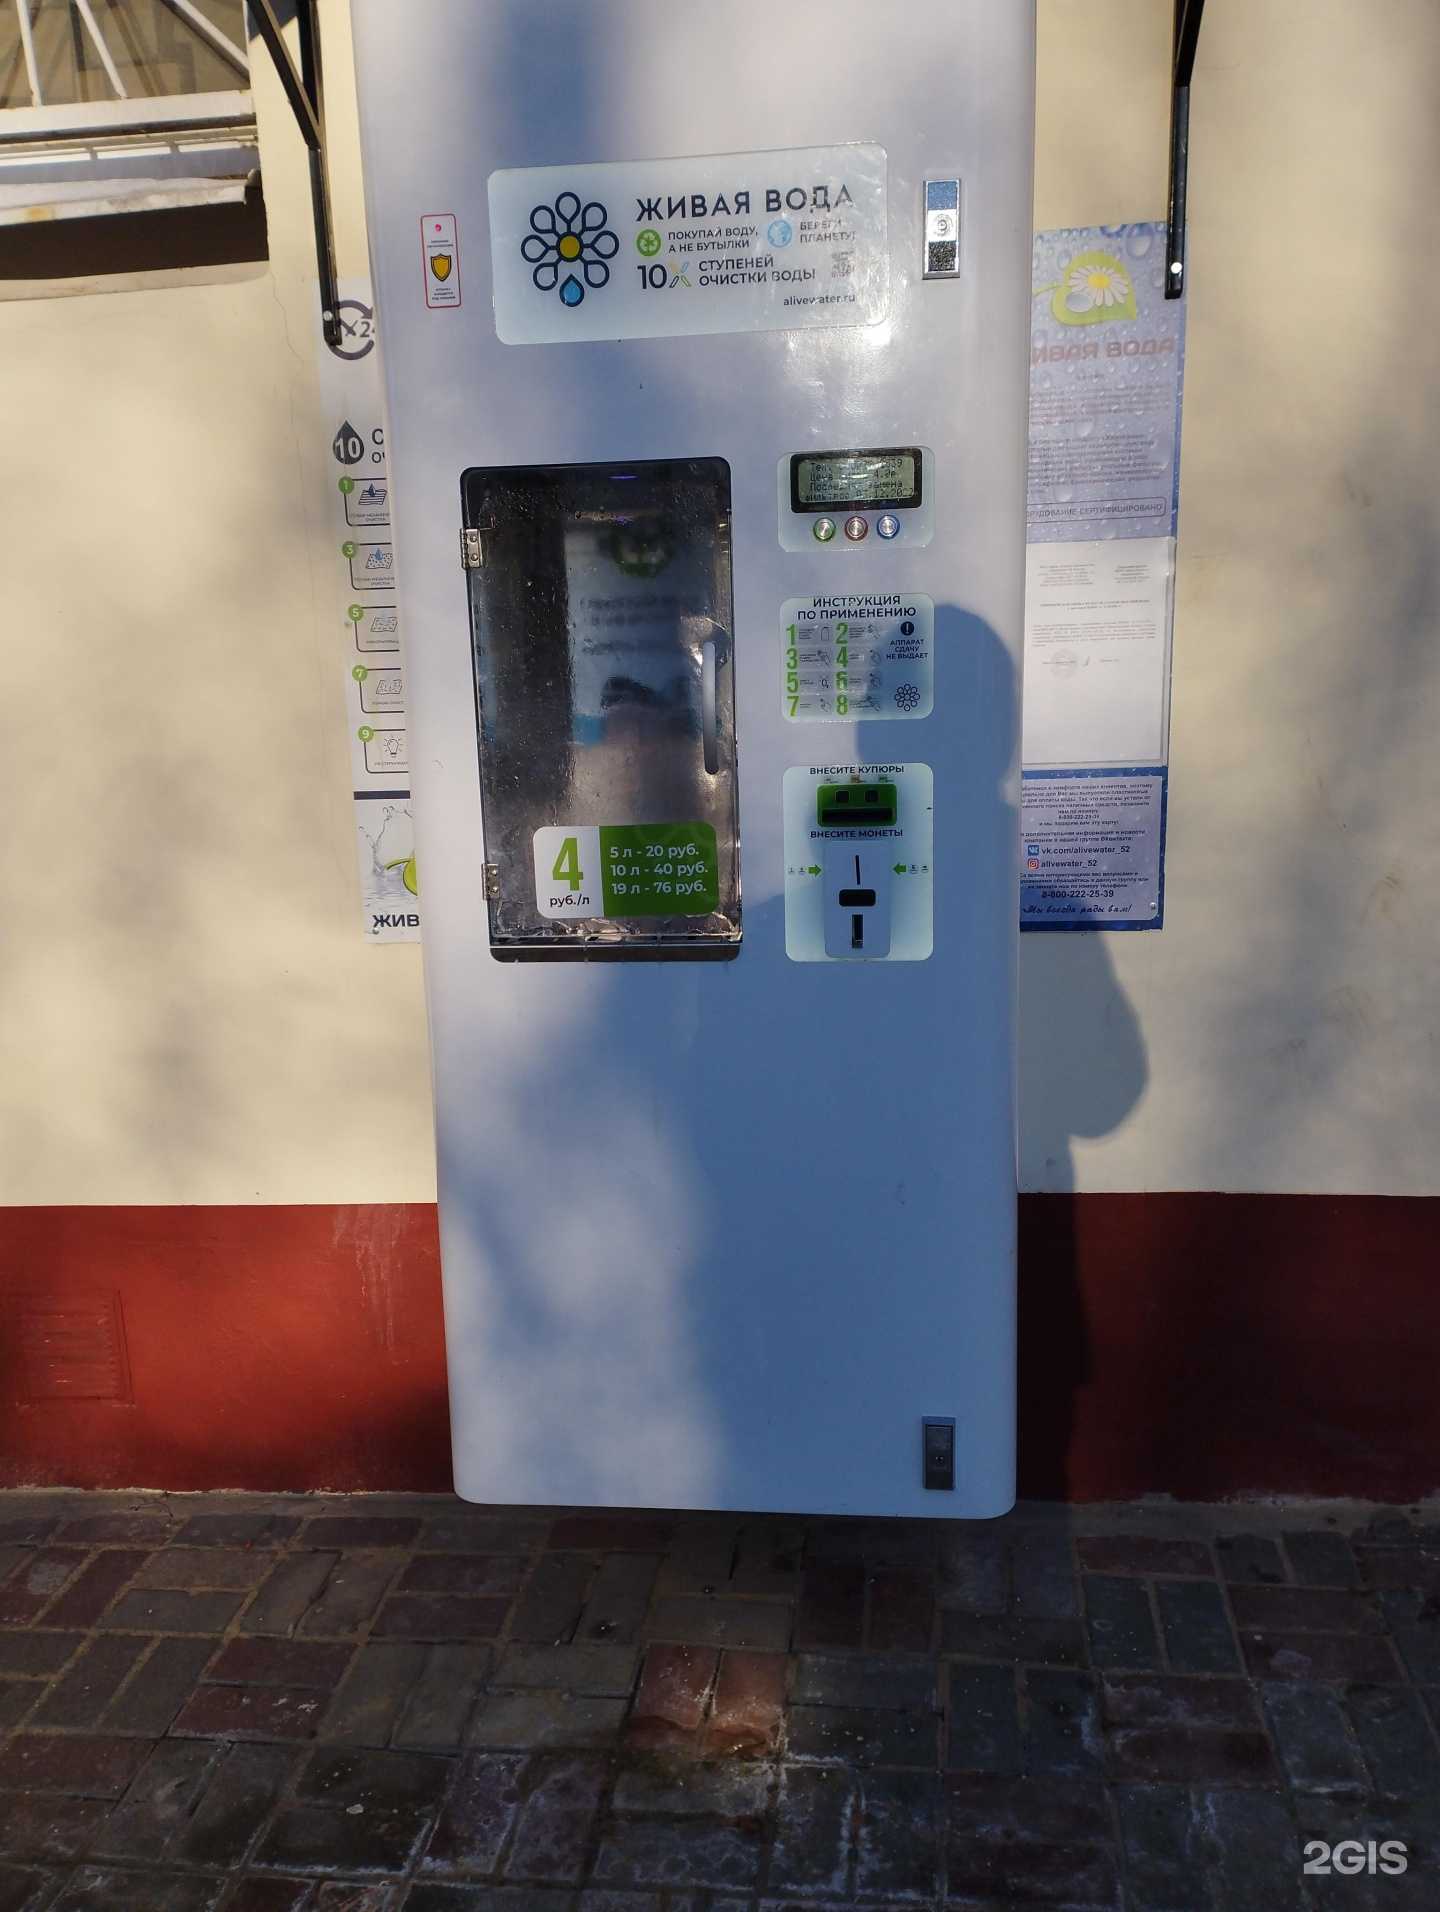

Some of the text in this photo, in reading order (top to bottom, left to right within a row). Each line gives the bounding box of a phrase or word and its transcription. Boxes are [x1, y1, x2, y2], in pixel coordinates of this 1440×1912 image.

[636, 184, 854, 221] ЖИВАЯ ВОДА
[668, 226, 759, 241] ПОКУПАЙ ВОДУ,
[668, 240, 750, 253] А НЕ БУТЫЛКИ
[699, 254, 774, 272] СТУПЕНЕЙ
[637, 263, 668, 289] 10
[699, 269, 816, 286] ОЧИСТКИ ВОДЫ
[784, 294, 856, 306] alivewater.ru
[335, 437, 361, 459] 10
[813, 595, 901, 607] ИНСТРУКЦИЯ
[352, 608, 359, 618] 5
[798, 607, 917, 620] ПО ПРИМЕНЕНИЮ
[786, 624, 797, 645] 1
[836, 623, 848, 644] 2
[786, 648, 798, 669] 3
[836, 647, 848, 668] 4
[786, 672, 798, 693] 5
[836, 671, 848, 691] 6
[787, 696, 799, 717] 7
[836, 695, 848, 715] 8
[362, 729, 369, 739] 9
[810, 765, 905, 775] ВНЕСИТЕ КУПЮРЫ
[810, 829, 903, 839] ВНЕСИТЕ МОНЕТЫ
[610, 848, 619, 858] 5
[622, 848, 632, 858] л
[646, 845, 664, 857] 20
[668, 844, 700, 859] руб.
[1041, 845, 1130, 855] vk.com/alivewater_52
[552, 837, 584, 891] 4
[610, 865, 626, 876] 10
[630, 865, 640, 875] л
[653, 863, 673, 875] 40
[677, 861, 708, 877] руб.
[1041, 860, 1098, 869] alivewater_52
[611, 883, 627, 894] 19
[630, 884, 640, 894] л
[653, 881, 671, 893] 76
[675, 880, 707, 895] руб.
[1042, 889, 1115, 898] 8-800-222-25-39
[550, 894, 590, 907] руб./л
[372, 914, 420, 927] ЖИВ
